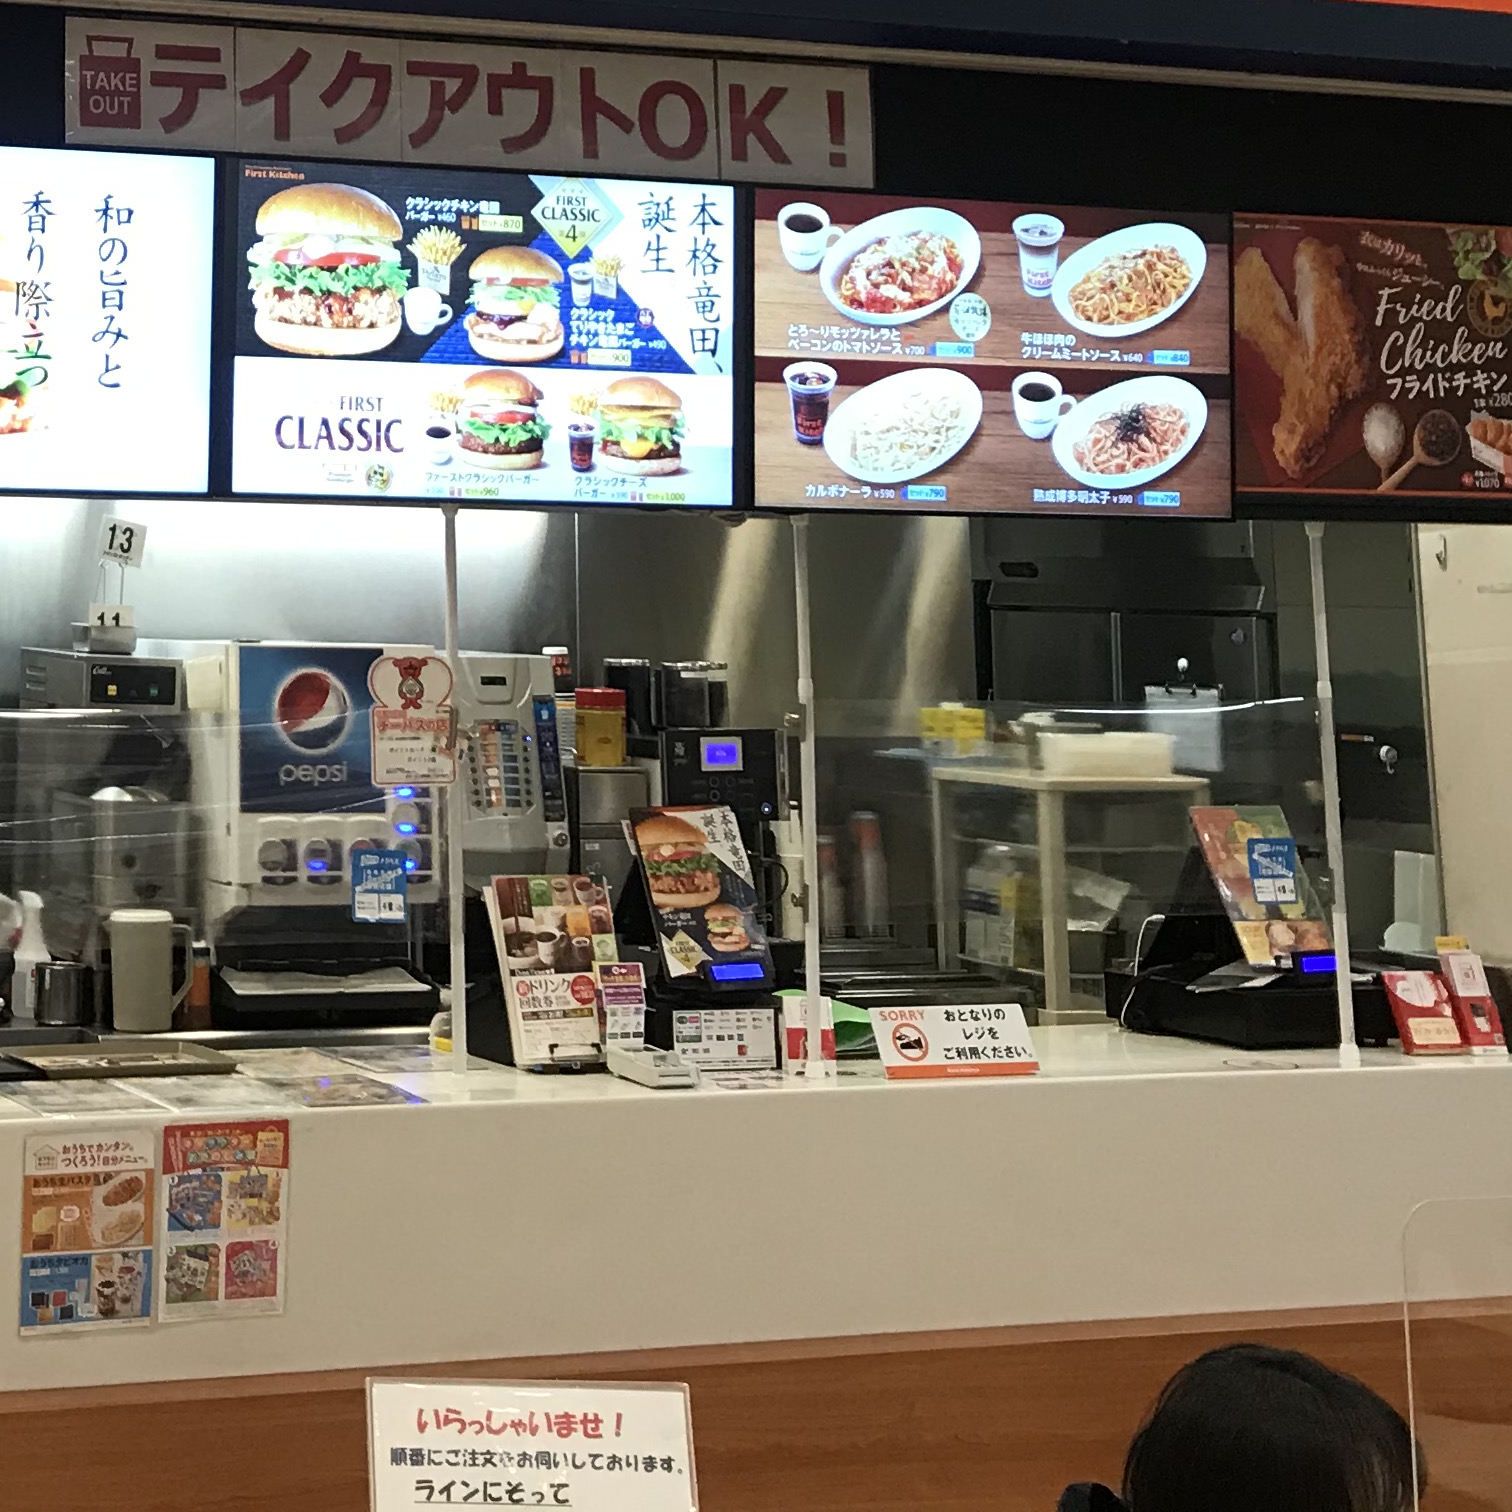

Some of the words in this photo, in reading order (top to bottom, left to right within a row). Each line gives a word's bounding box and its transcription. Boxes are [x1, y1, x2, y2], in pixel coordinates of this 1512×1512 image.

[81, 69, 139, 96] TAKE
[89, 94, 134, 119] OUT
[245, 168, 267, 178] First
[270, 170, 305, 180] Kitchen
[556, 195, 587, 207] FIRST
[405, 210, 436, 222] バーガー
[437, 211, 457, 223] ¥460
[541, 206, 601, 222] CLASSIC
[638, 192, 676, 275] 誕生
[14, 189, 57, 388] 香り際立つ
[92, 193, 134, 389] 和の旨みと
[1375, 284, 1465, 327] Fried
[570, 307, 615, 322] クラシック
[787, 339, 903, 355] ベーコンのトマトソース
[1020, 332, 1077, 348] 牛ほほ肉の
[1020, 346, 1122, 363] クリームミートソース
[1380, 322, 1509, 375] Chicken
[1385, 369, 1508, 400] フライドチキン
[340, 395, 383, 412] FIRST
[274, 414, 404, 455] CLASSIC
[425, 471, 540, 484] ファーストクラシックバーガー
[574, 475, 648, 488] クラシックチーズ
[573, 488, 607, 499] バーガー
[805, 484, 873, 499] カルボナーラ
[873, 489, 896, 500] ¥590
[1112, 494, 1134, 504] ¥590
[108, 523, 134, 554] 13
[278, 760, 350, 788] pepsi
[529, 978, 571, 995] ドリンク
[879, 1009, 926, 1022] SORRY
[944, 1008, 1006, 1022] おとなりの
[962, 1026, 1000, 1041] レジを
[943, 1046, 1033, 1061] ご利用ください。
[414, 1479, 572, 1504] ラインにそって
